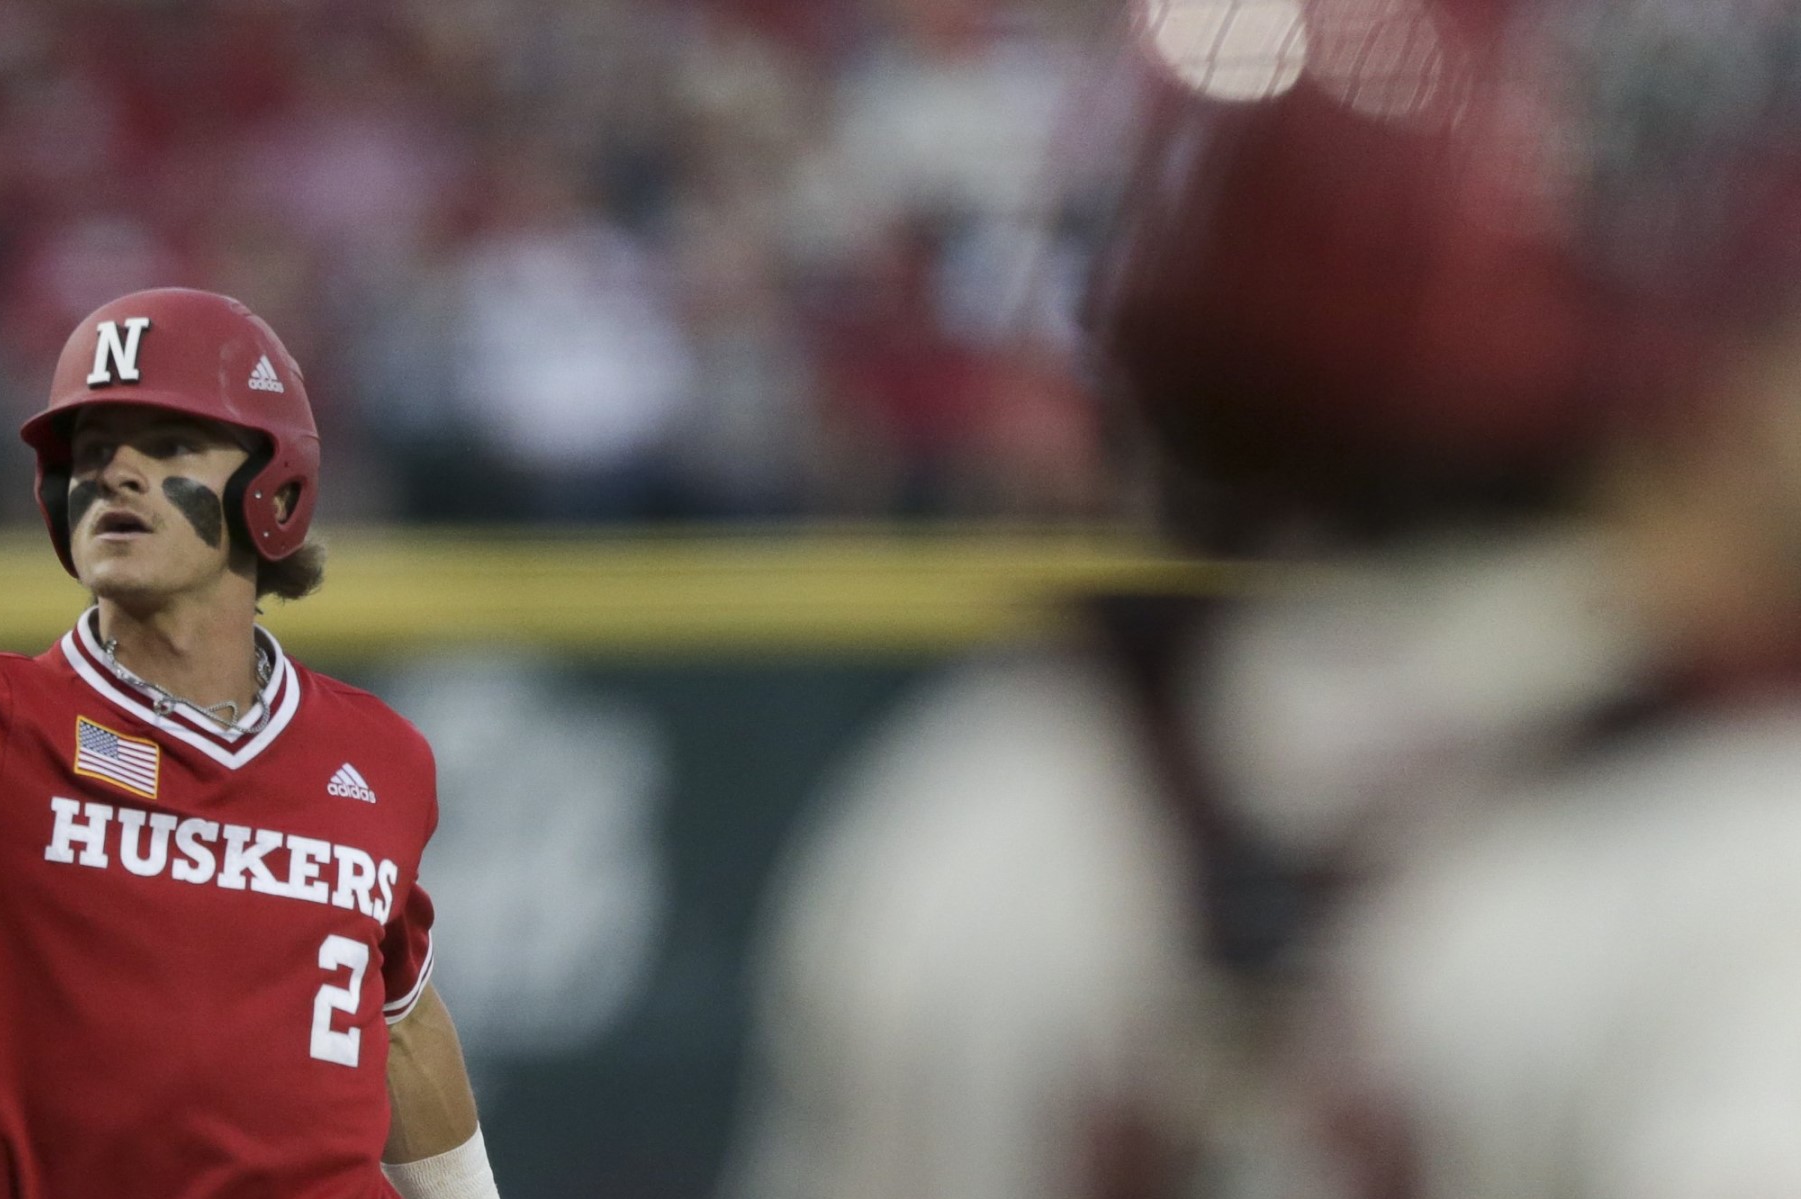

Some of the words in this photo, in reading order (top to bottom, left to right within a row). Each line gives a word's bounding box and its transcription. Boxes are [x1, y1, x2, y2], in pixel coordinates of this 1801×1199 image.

[86, 317, 150, 385] N
[327, 781, 376, 803] adidas
[44, 796, 398, 925] HUSKERS
[310, 935, 369, 1067] 2
